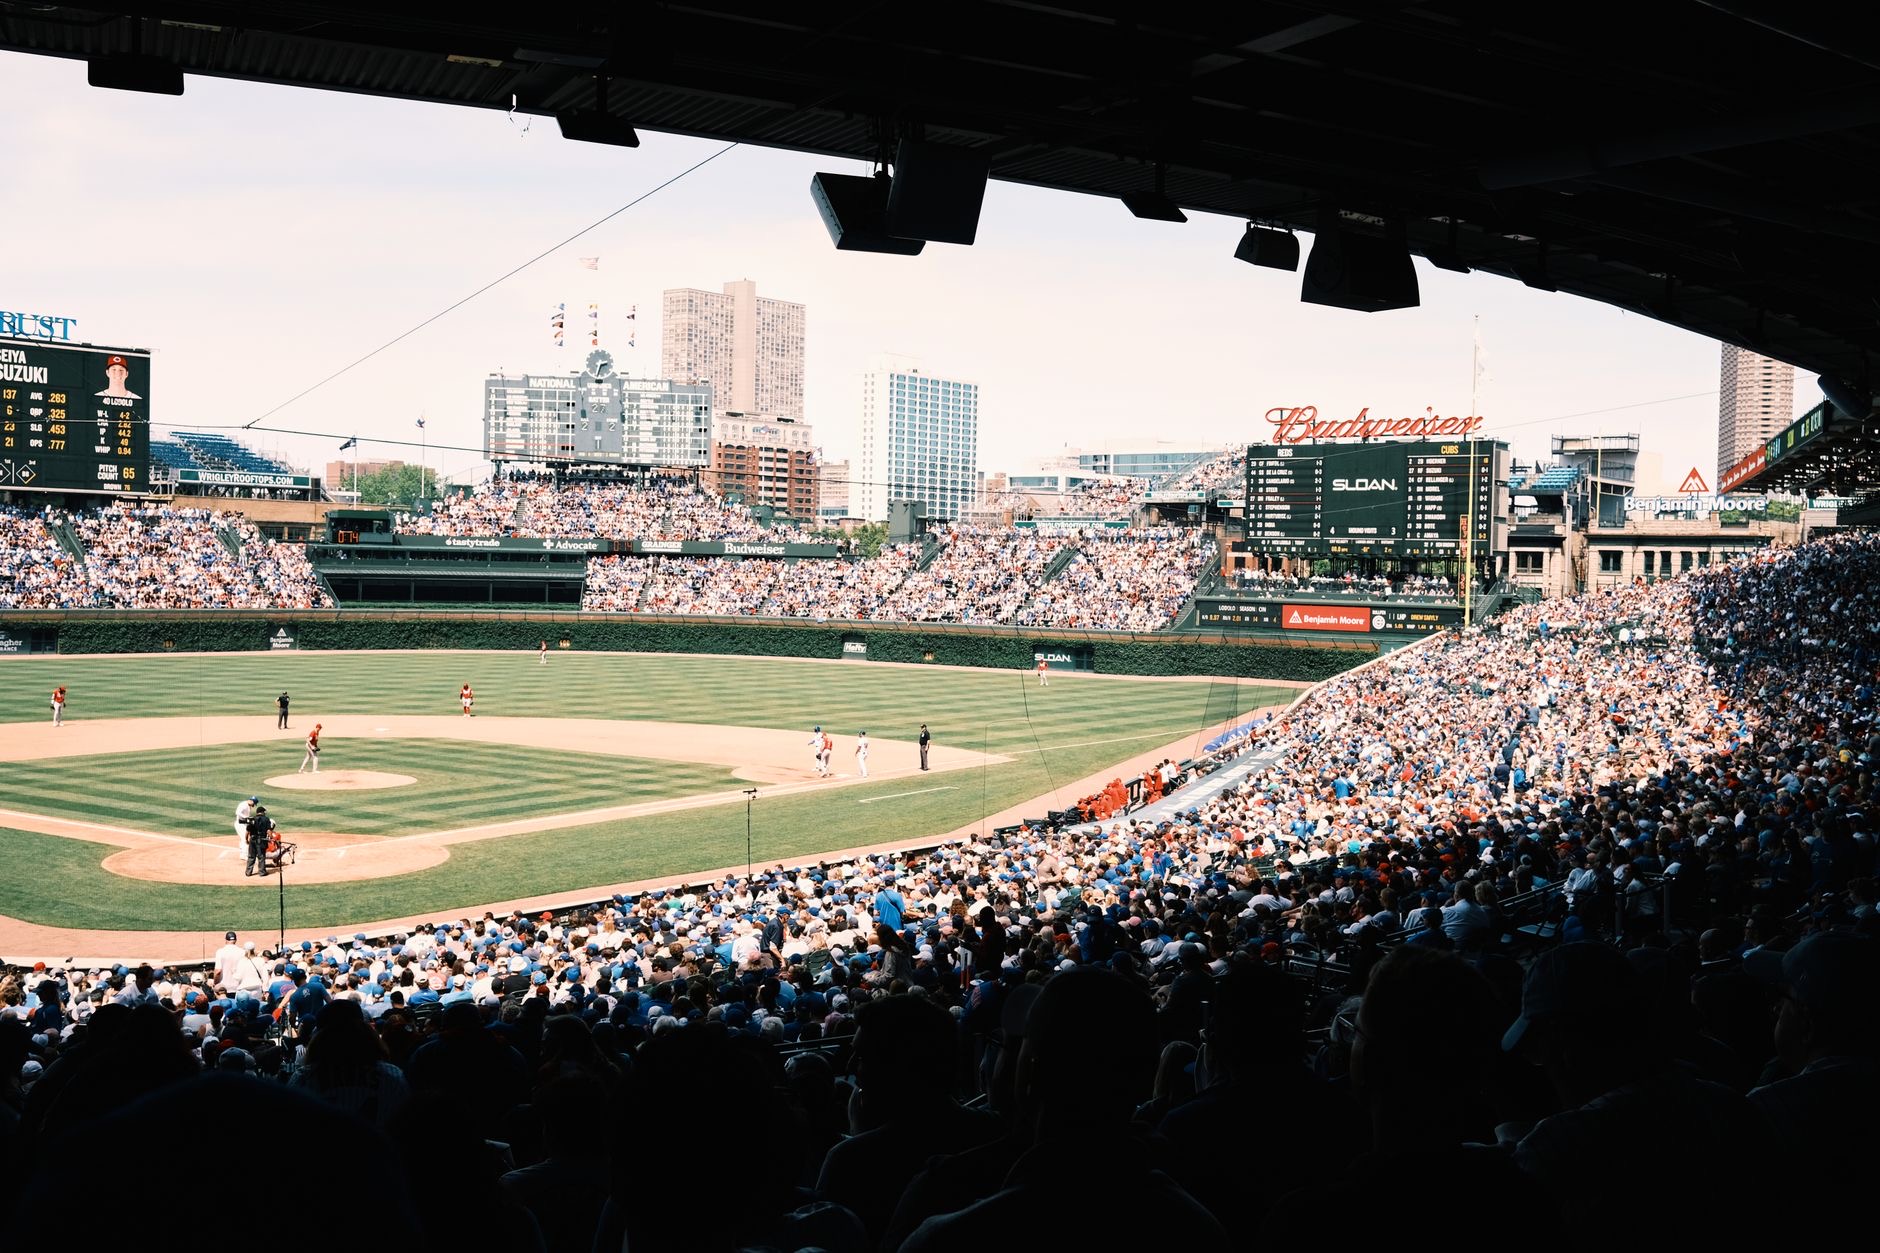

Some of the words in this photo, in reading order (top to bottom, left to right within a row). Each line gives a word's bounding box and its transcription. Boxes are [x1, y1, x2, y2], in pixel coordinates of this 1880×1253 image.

[0, 311, 77, 340] RUST
[0, 349, 26, 364] EIYA
[529, 378, 576, 388] NATIONAL
[623, 381, 669, 391] AMERICAN
[3, 389, 17, 399] 137
[30, 392, 43, 400] AVG
[7, 405, 13, 415] 6
[30, 423, 43, 432] SLG
[1265, 405, 1483, 443] Budweiser
[5, 437, 14, 447] 21
[30, 439, 43, 447] OPS
[1277, 448, 1293, 457] REDS
[1441, 445, 1459, 455] CUBS
[97, 472, 118, 480] COUNT
[123, 467, 135, 480] 65
[99, 464, 117, 473] PITCH
[198, 471, 294, 485] WRIGLEYROOFTOPS.COM
[1624, 495, 1702, 515] Benjamin
[1709, 496, 1766, 511] Moore
[1330, 526, 1335, 535] 4
[1391, 527, 1396, 535] 3
[452, 537, 500, 548] tastytrade
[556, 540, 597, 550] Advocate
[724, 542, 785, 554] Budweiser
[1304, 614, 1338, 625] Benjamin
[1340, 615, 1364, 625] Moore
